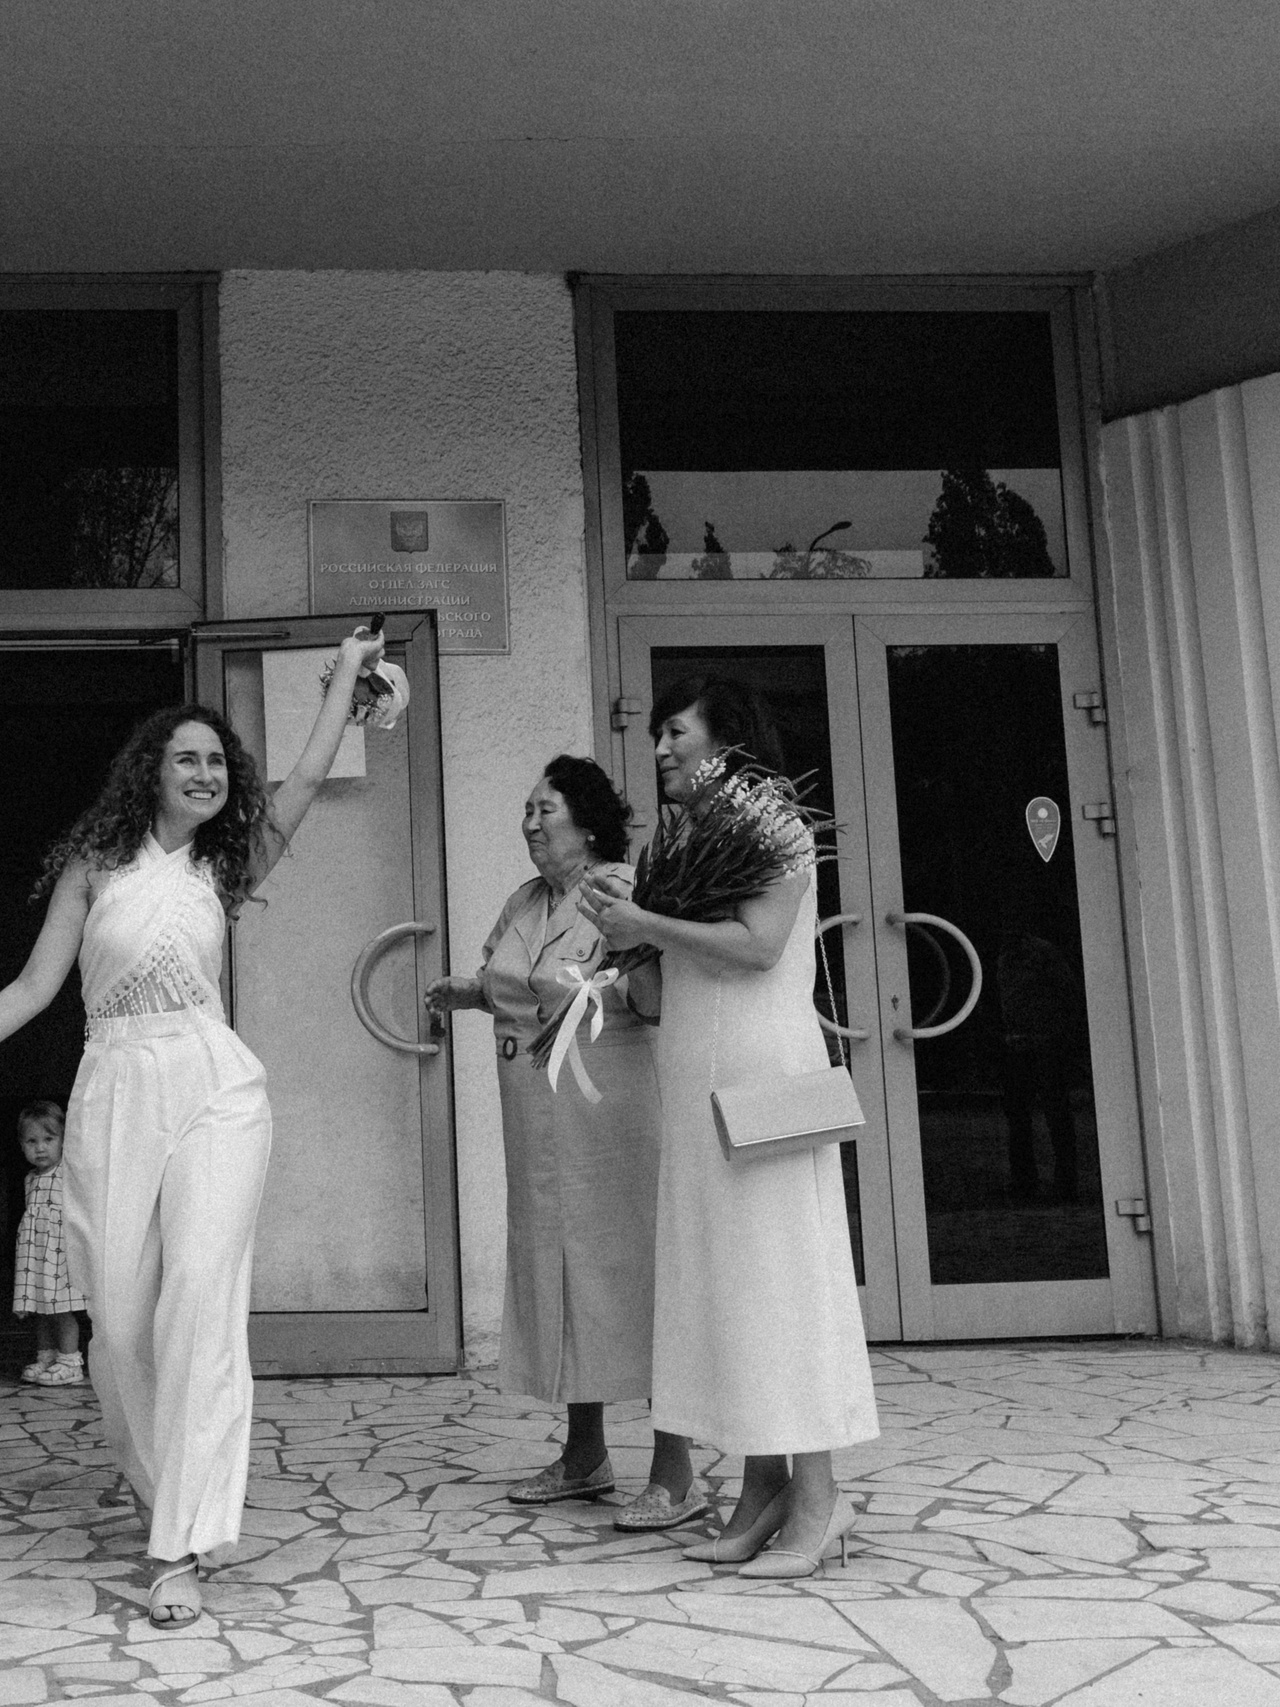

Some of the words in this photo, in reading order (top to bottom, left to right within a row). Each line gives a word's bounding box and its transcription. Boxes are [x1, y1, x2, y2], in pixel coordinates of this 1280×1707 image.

[320, 561, 412, 574] РОССИЙСКАЯ
[415, 562, 498, 575] ФЕДЕРАЦИЯ
[369, 579, 414, 590] ОТДЕЛ
[417, 579, 451, 590] ЗАГС
[349, 595, 471, 606] АДМИНИСТРАЦИИ
